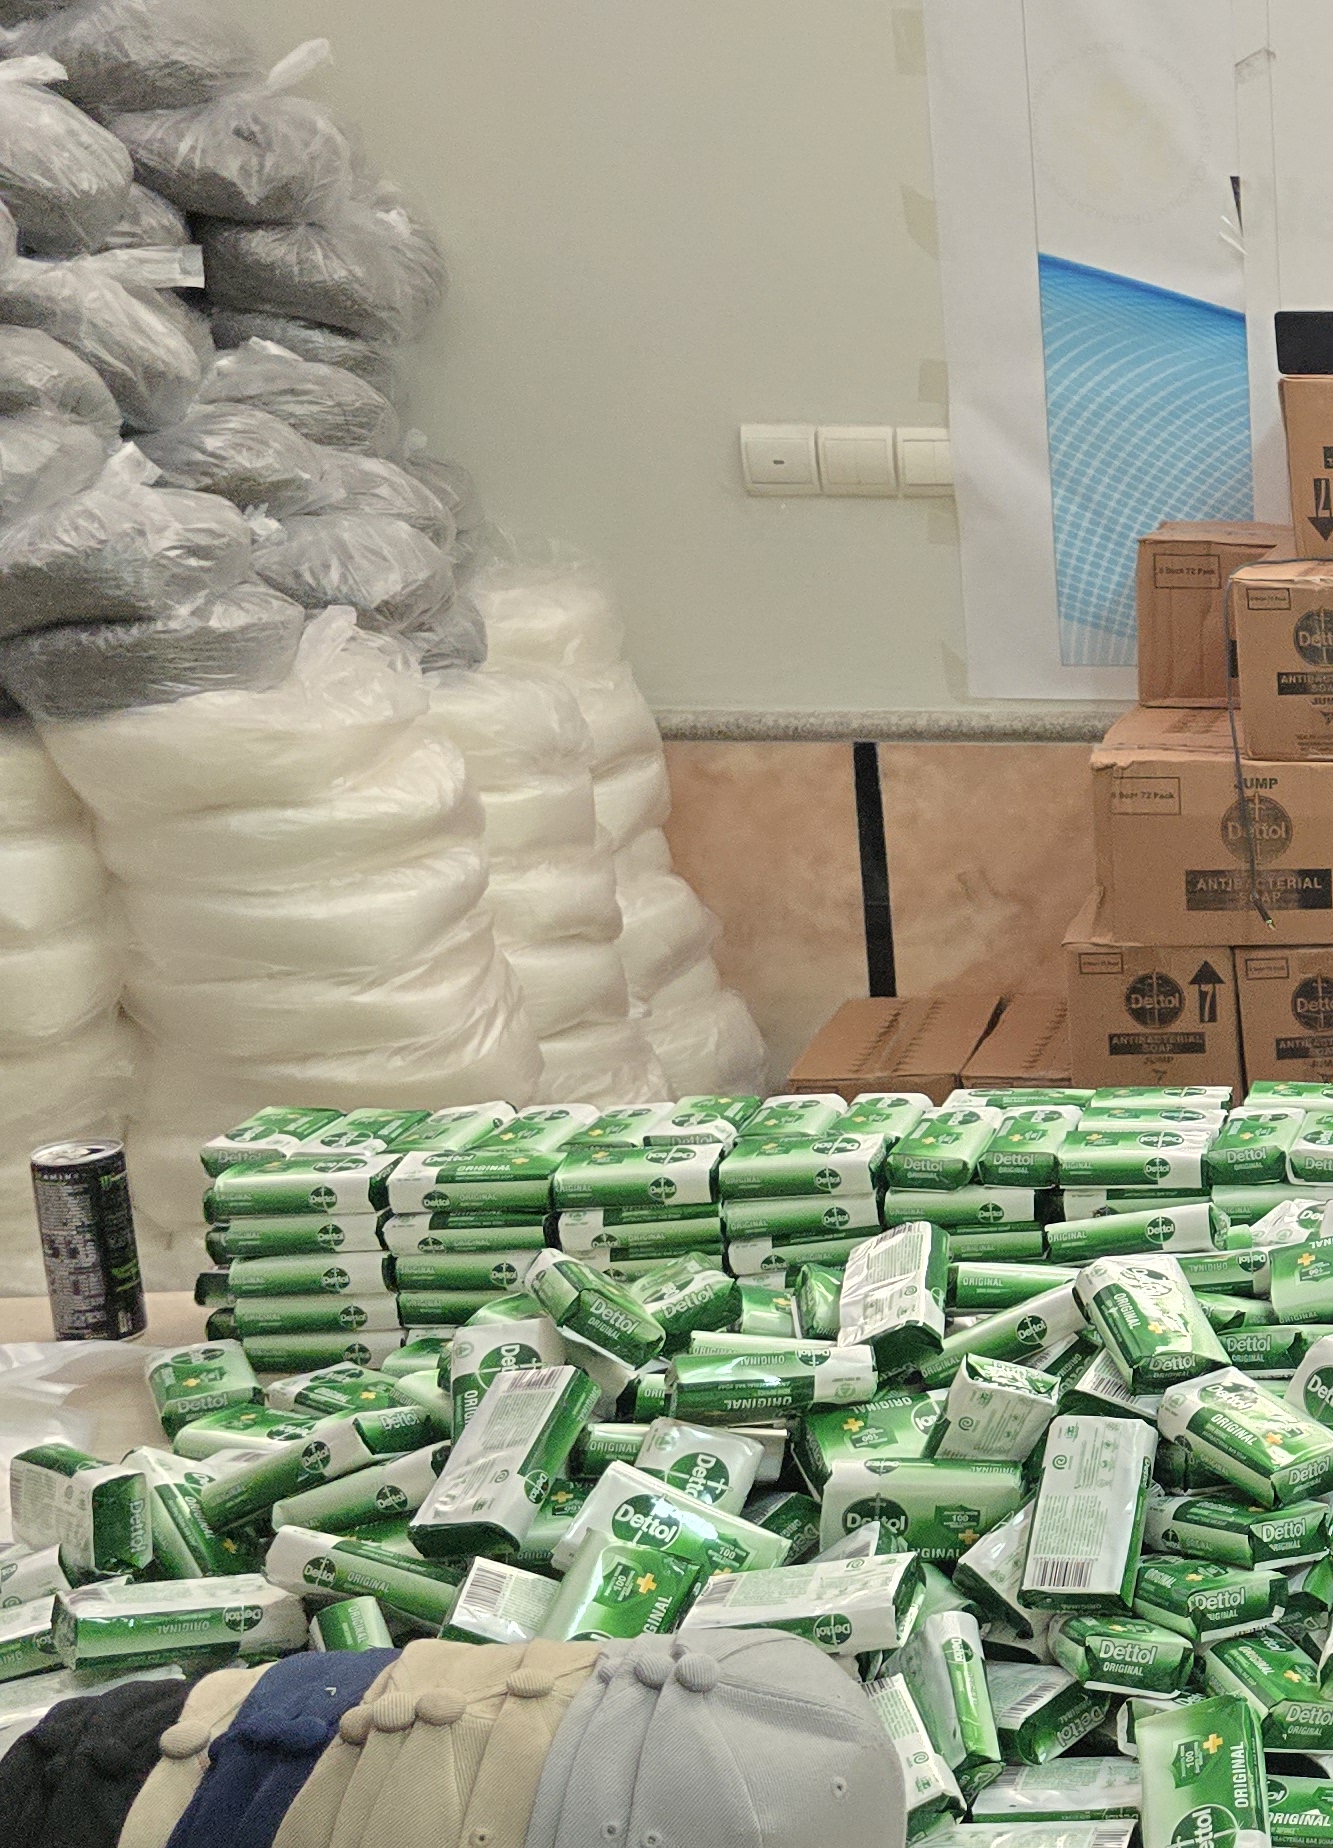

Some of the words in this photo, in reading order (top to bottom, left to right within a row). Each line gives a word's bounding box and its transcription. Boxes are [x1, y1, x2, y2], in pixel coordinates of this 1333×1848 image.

[1227, 824, 1286, 840] Dettol
[1130, 994, 1179, 1009] Dettol
[425, 1153, 475, 1165] Dettol
[903, 1158, 944, 1172] Dettol
[993, 1153, 1034, 1166] Dettol
[1227, 1148, 1267, 1164] Dettol
[1146, 1223, 1175, 1235] Dettol
[963, 1277, 1003, 1287] ORIGINAL
[662, 1284, 715, 1320] Dettol
[1113, 1292, 1142, 1329] ORIGINAL
[589, 1298, 640, 1335] Dettol
[587, 1317, 622, 1341] ORIGINAL
[1226, 1334, 1271, 1352] Dettol
[177, 1393, 229, 1414] Dettol
[724, 1396, 792, 1409] ORIGINAL
[1210, 1413, 1258, 1446] ORIGINAL
[127, 1498, 146, 1554] Dettol
[615, 1504, 679, 1544] Dettol
[347, 1571, 391, 1592] ORIGINAL
[157, 1621, 210, 1635] ORIGINAL
[1099, 1639, 1157, 1665] Dettol
[1102, 1661, 1144, 1677] ORIGINAL
[1233, 1741, 1249, 1809] ORIGINAL
